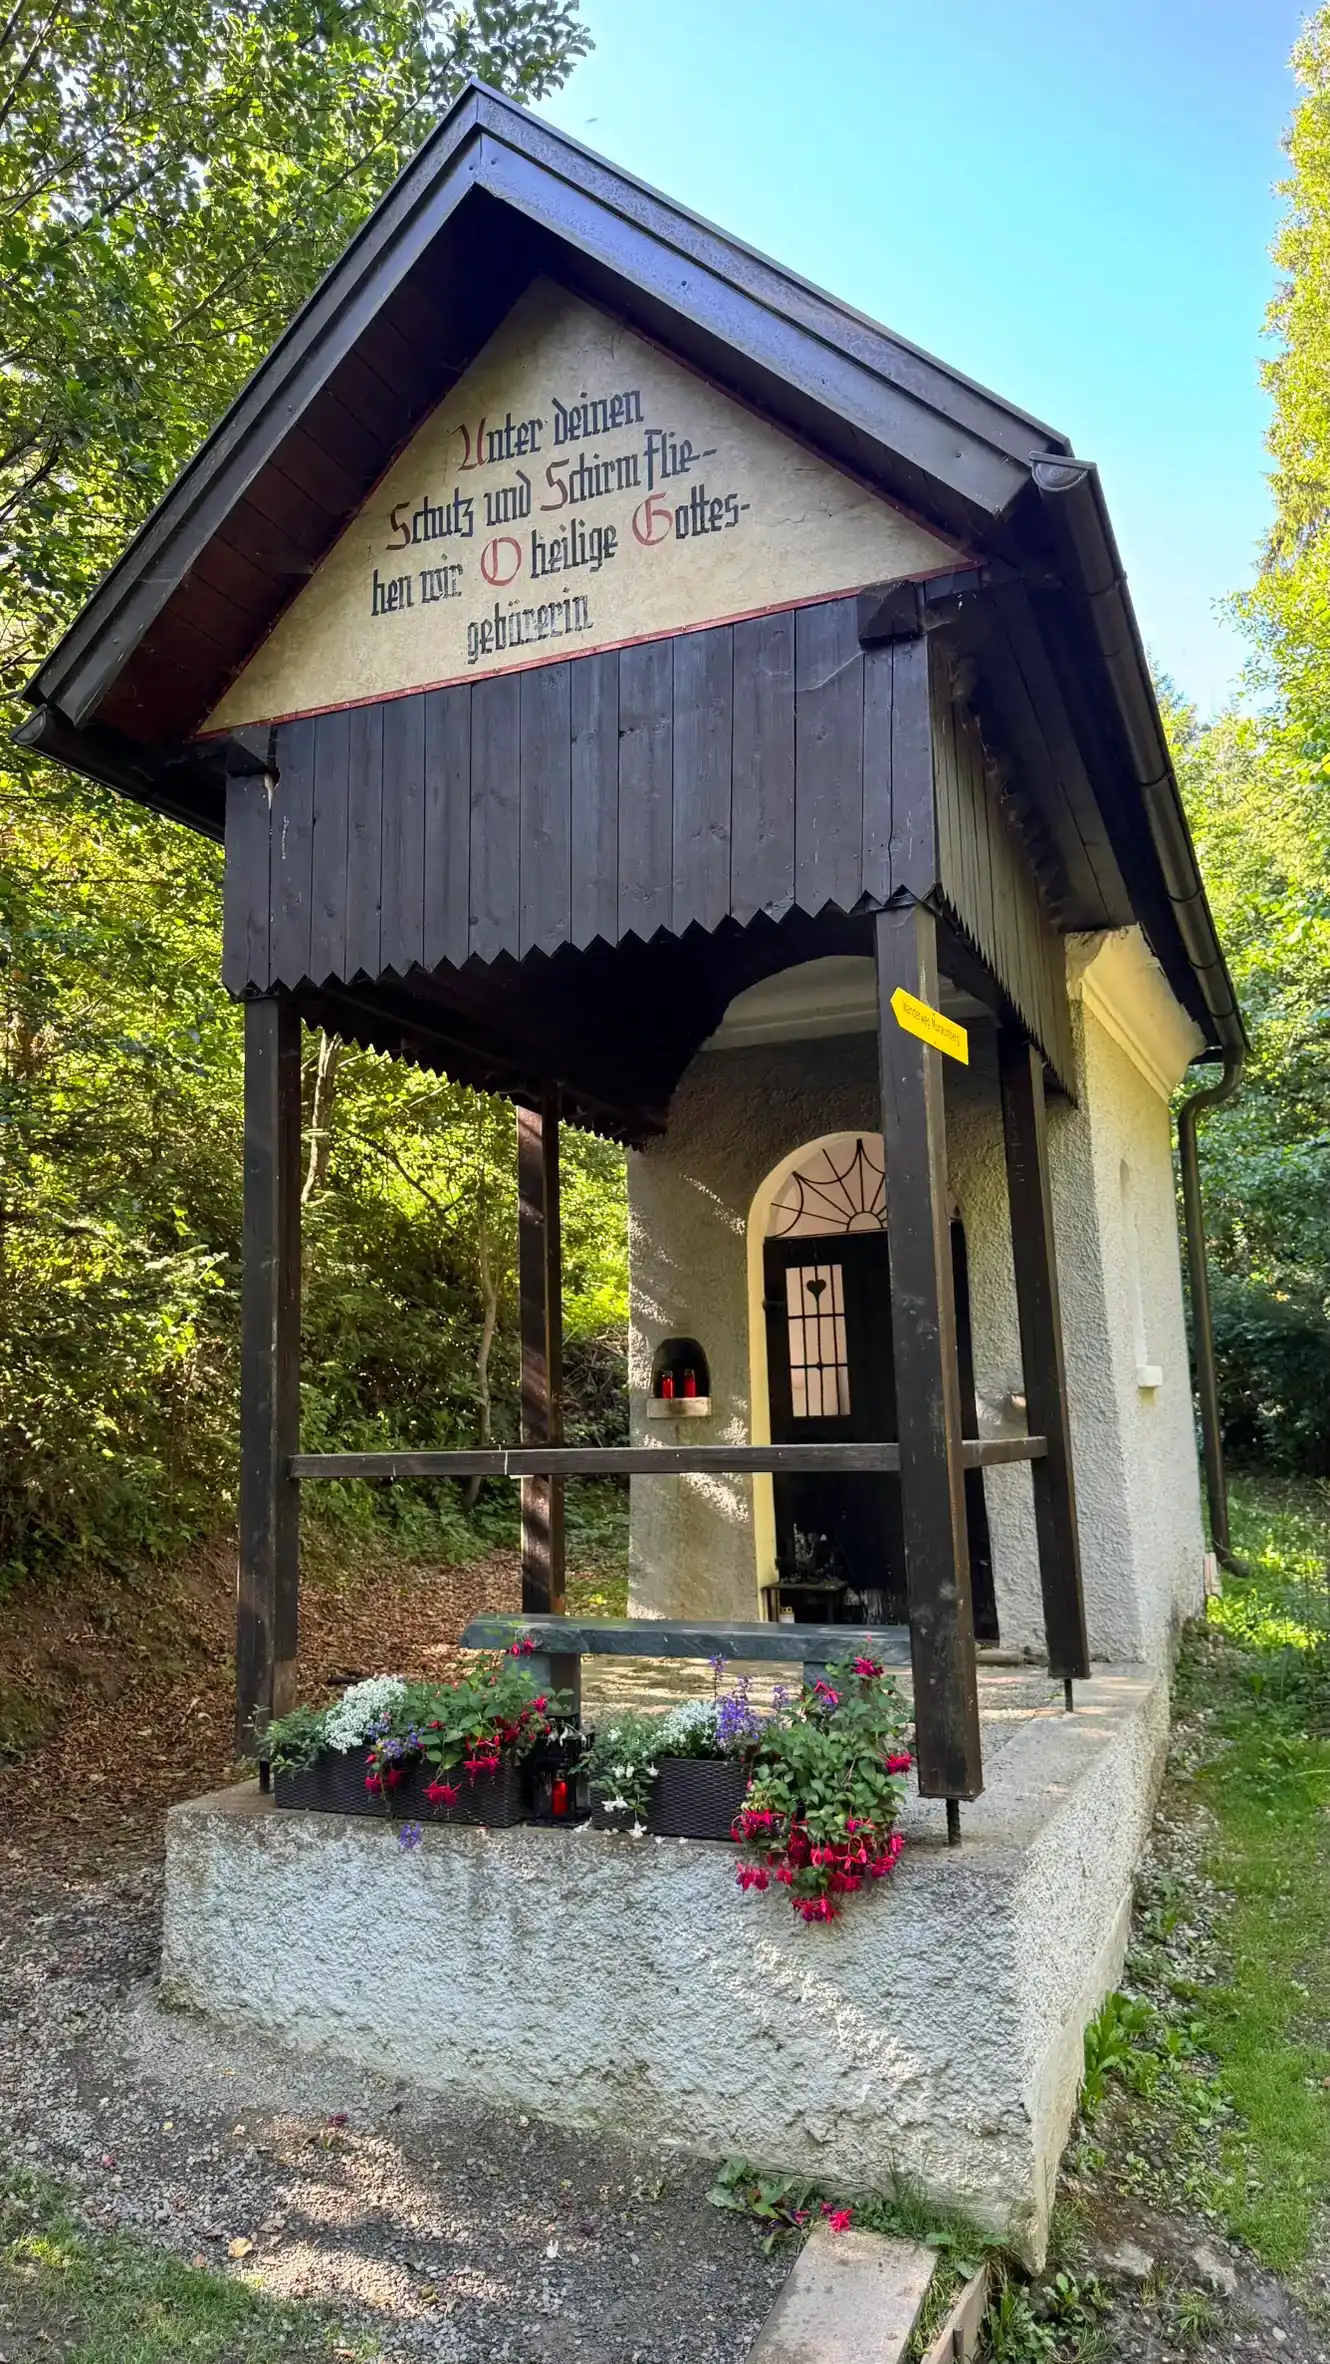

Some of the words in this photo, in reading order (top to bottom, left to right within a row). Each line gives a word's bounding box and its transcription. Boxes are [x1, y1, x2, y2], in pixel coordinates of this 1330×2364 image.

[452, 412, 543, 473] Unter
[551, 390, 645, 447] deinen
[385, 486, 475, 551] Schutz
[483, 469, 532, 527] und
[540, 452, 642, 512] Schirm
[371, 568, 415, 616] hen
[419, 553, 464, 603] wir
[481, 536, 522, 587] O
[531, 518, 619, 579] heilige
